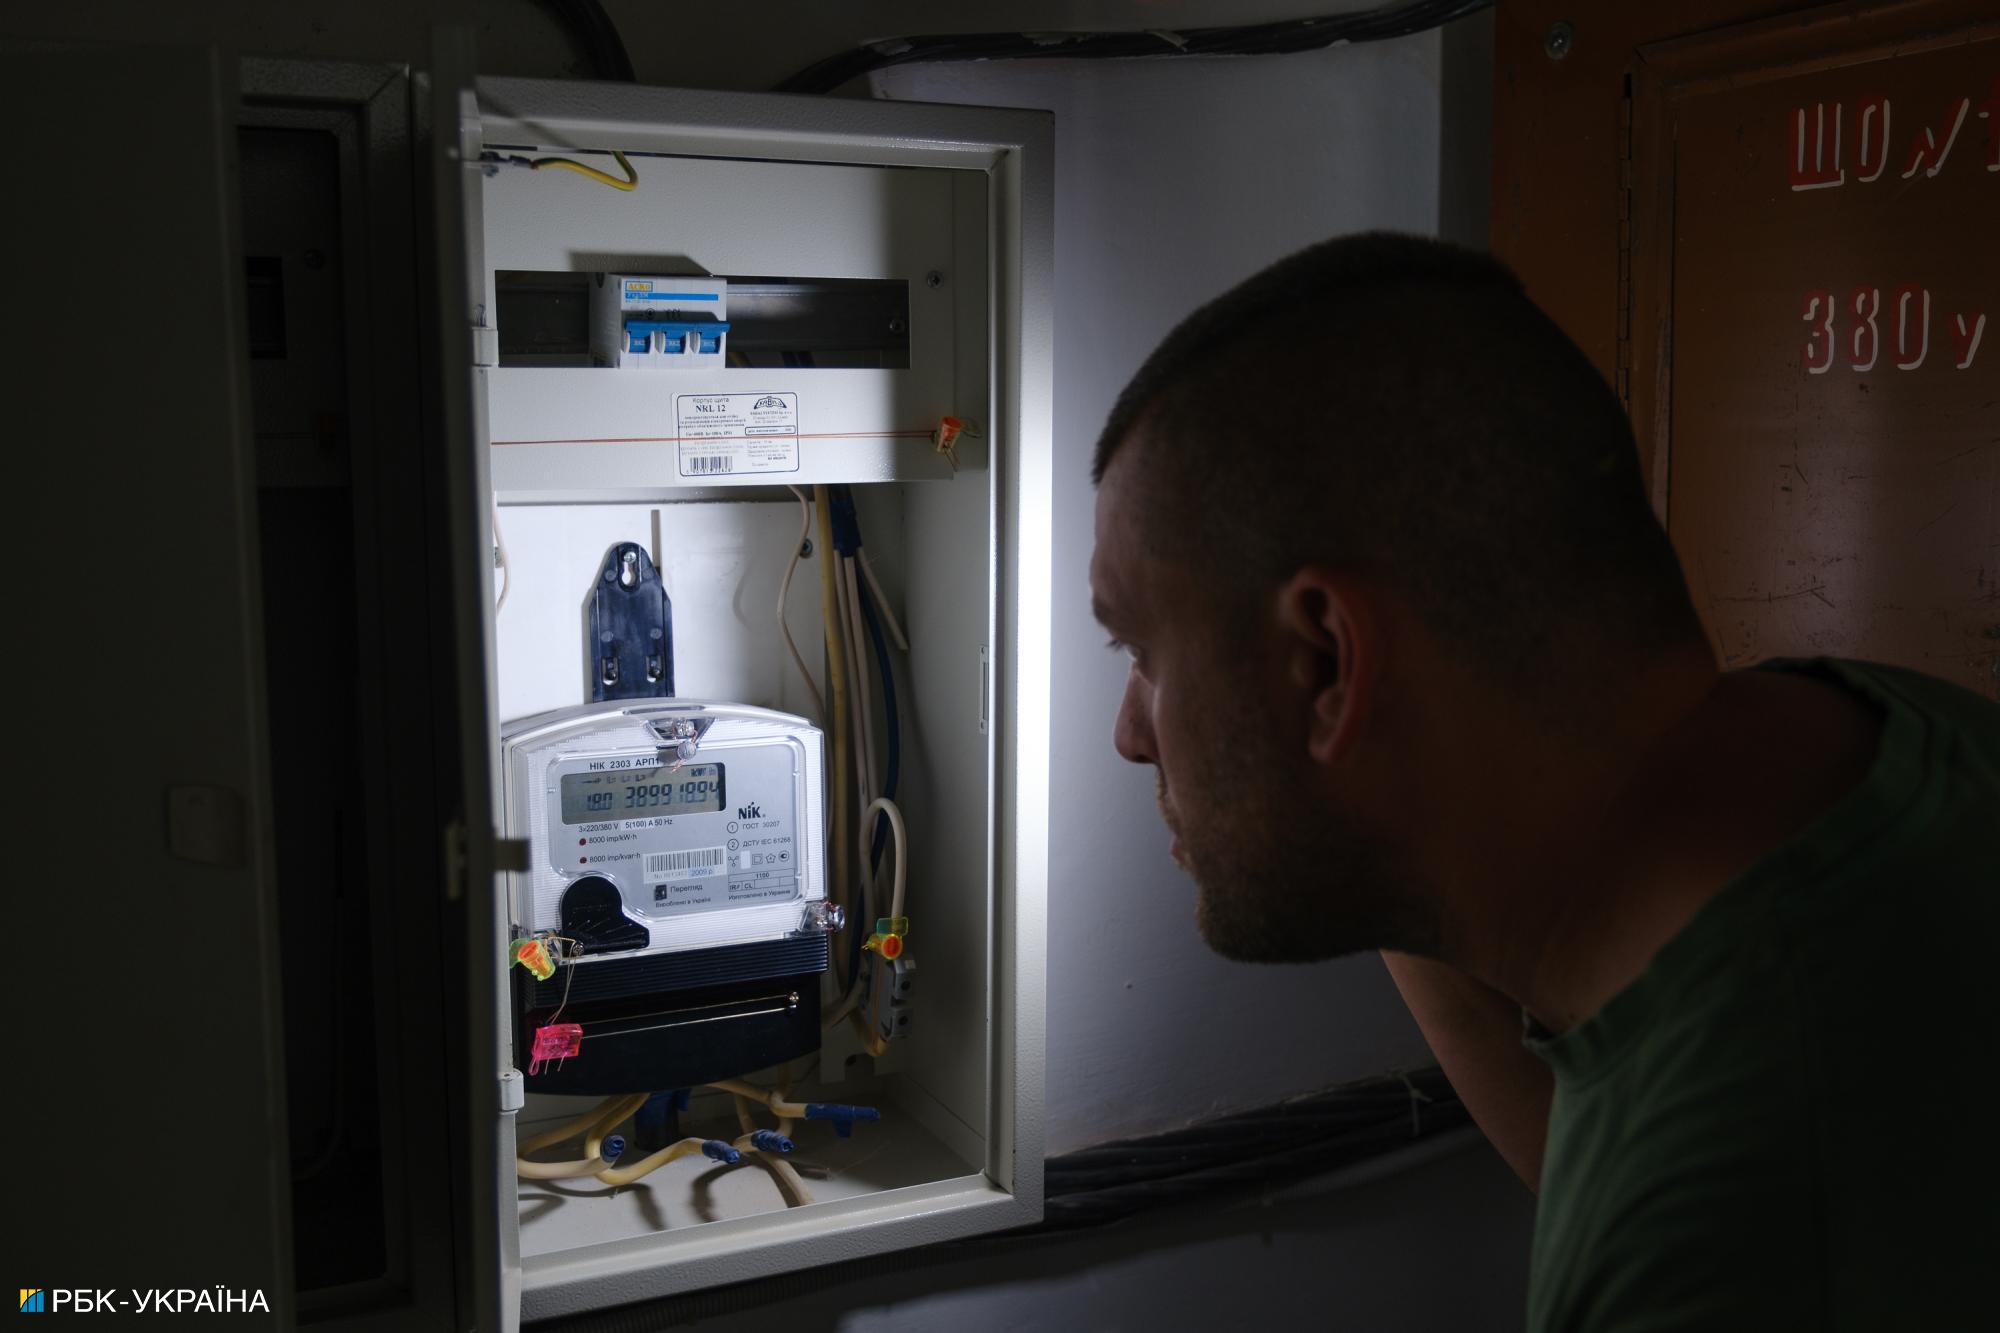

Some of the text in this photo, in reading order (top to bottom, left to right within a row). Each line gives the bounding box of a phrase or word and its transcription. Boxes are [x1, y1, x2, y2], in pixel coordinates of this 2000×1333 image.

[1801, 283, 1930, 374] 380
[695, 404, 726, 412] NRL 12
[610, 760, 631, 769] 2303
[625, 821, 647, 829] 5(100)
[663, 818, 673, 826] Hz
[742, 822, 760, 830] ГОСТ
[589, 836, 605, 844] 8000
[589, 855, 606, 863] 8000
